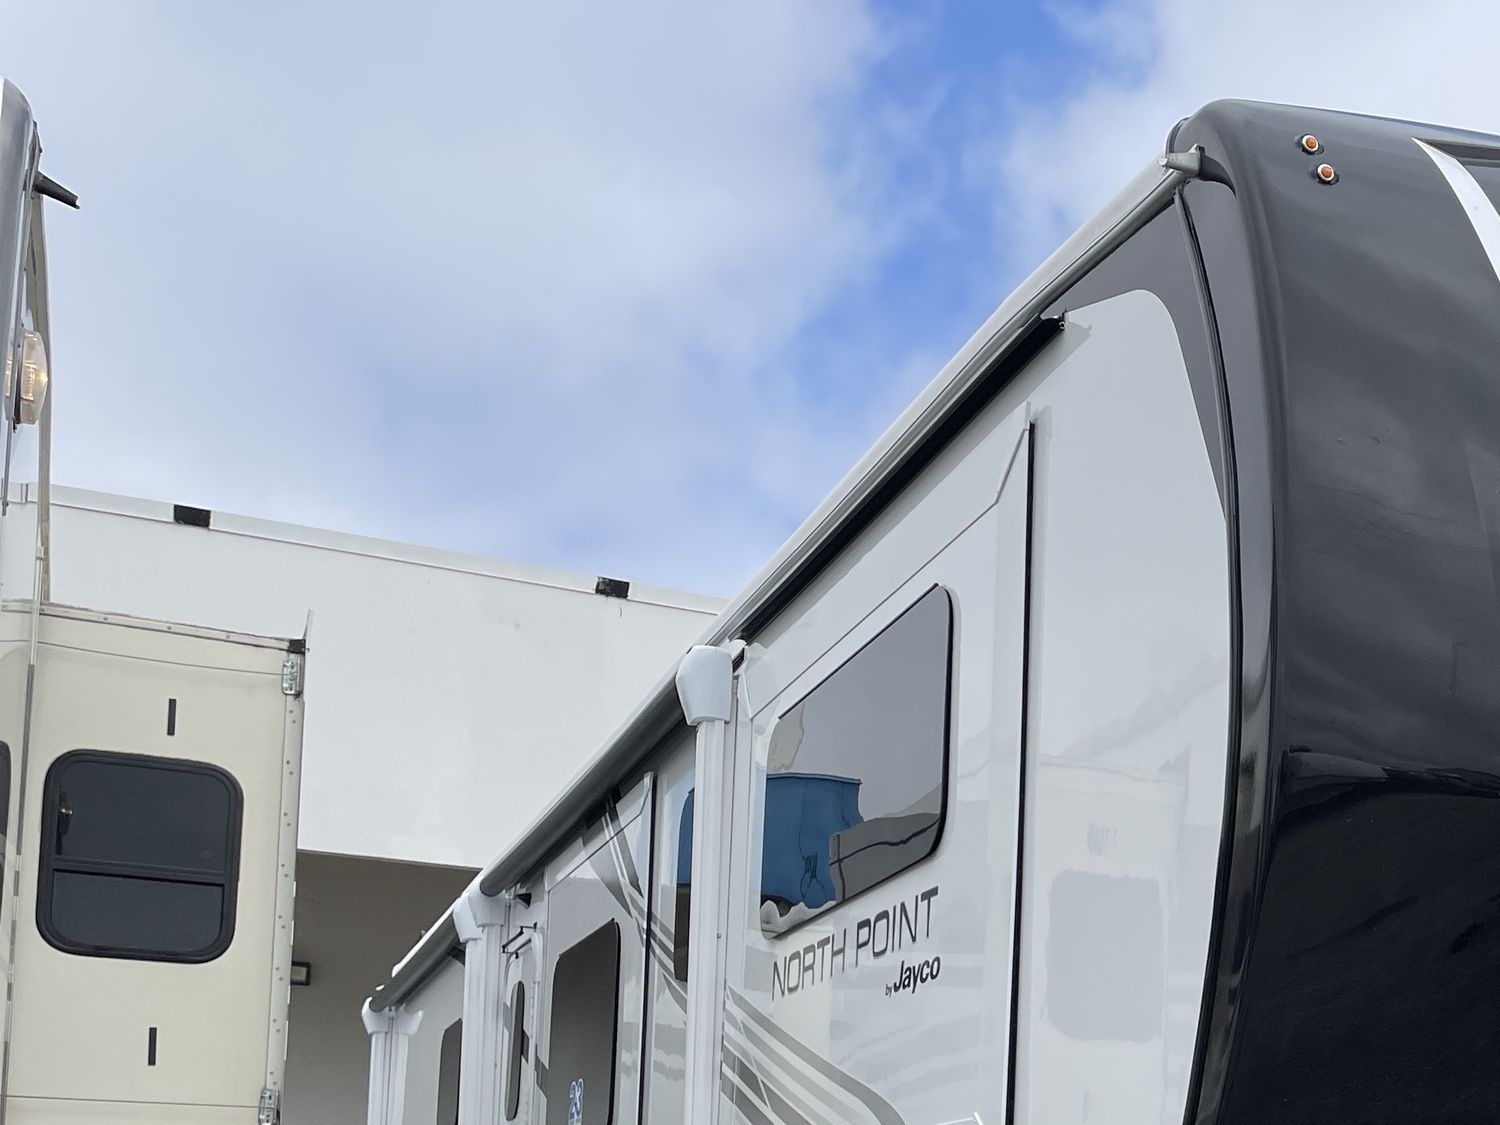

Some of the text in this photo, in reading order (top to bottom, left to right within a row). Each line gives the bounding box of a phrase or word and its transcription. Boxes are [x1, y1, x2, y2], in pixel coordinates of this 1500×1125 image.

[772, 886, 939, 1001] NORTH POINT
[885, 956, 941, 998] by Jayco
